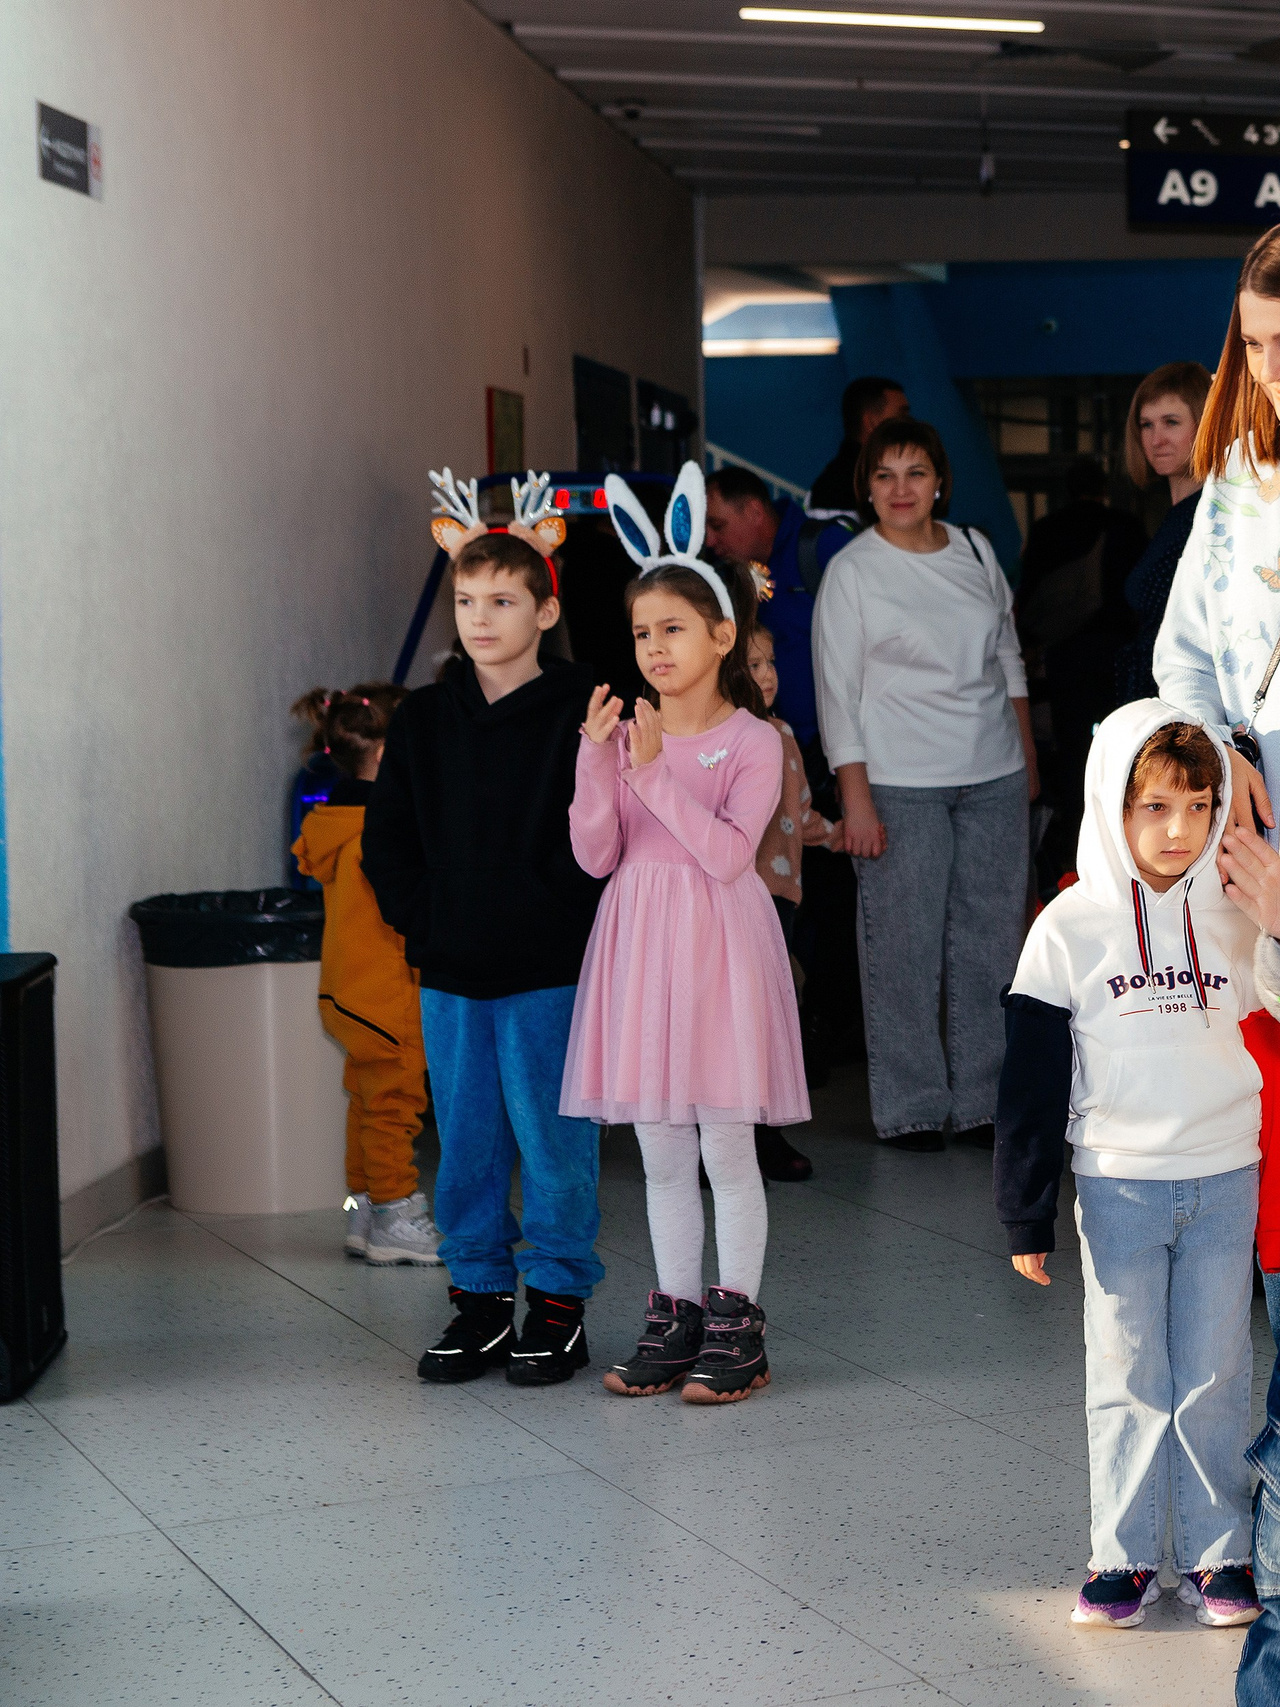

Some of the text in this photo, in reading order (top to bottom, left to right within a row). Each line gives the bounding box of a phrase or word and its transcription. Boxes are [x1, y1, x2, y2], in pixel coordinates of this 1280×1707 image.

[1243, 124, 1260, 145] 4
[1157, 168, 1219, 207] А9
[1106, 965, 1229, 999] Bonjour
[1158, 1002, 1187, 1014] 1998
